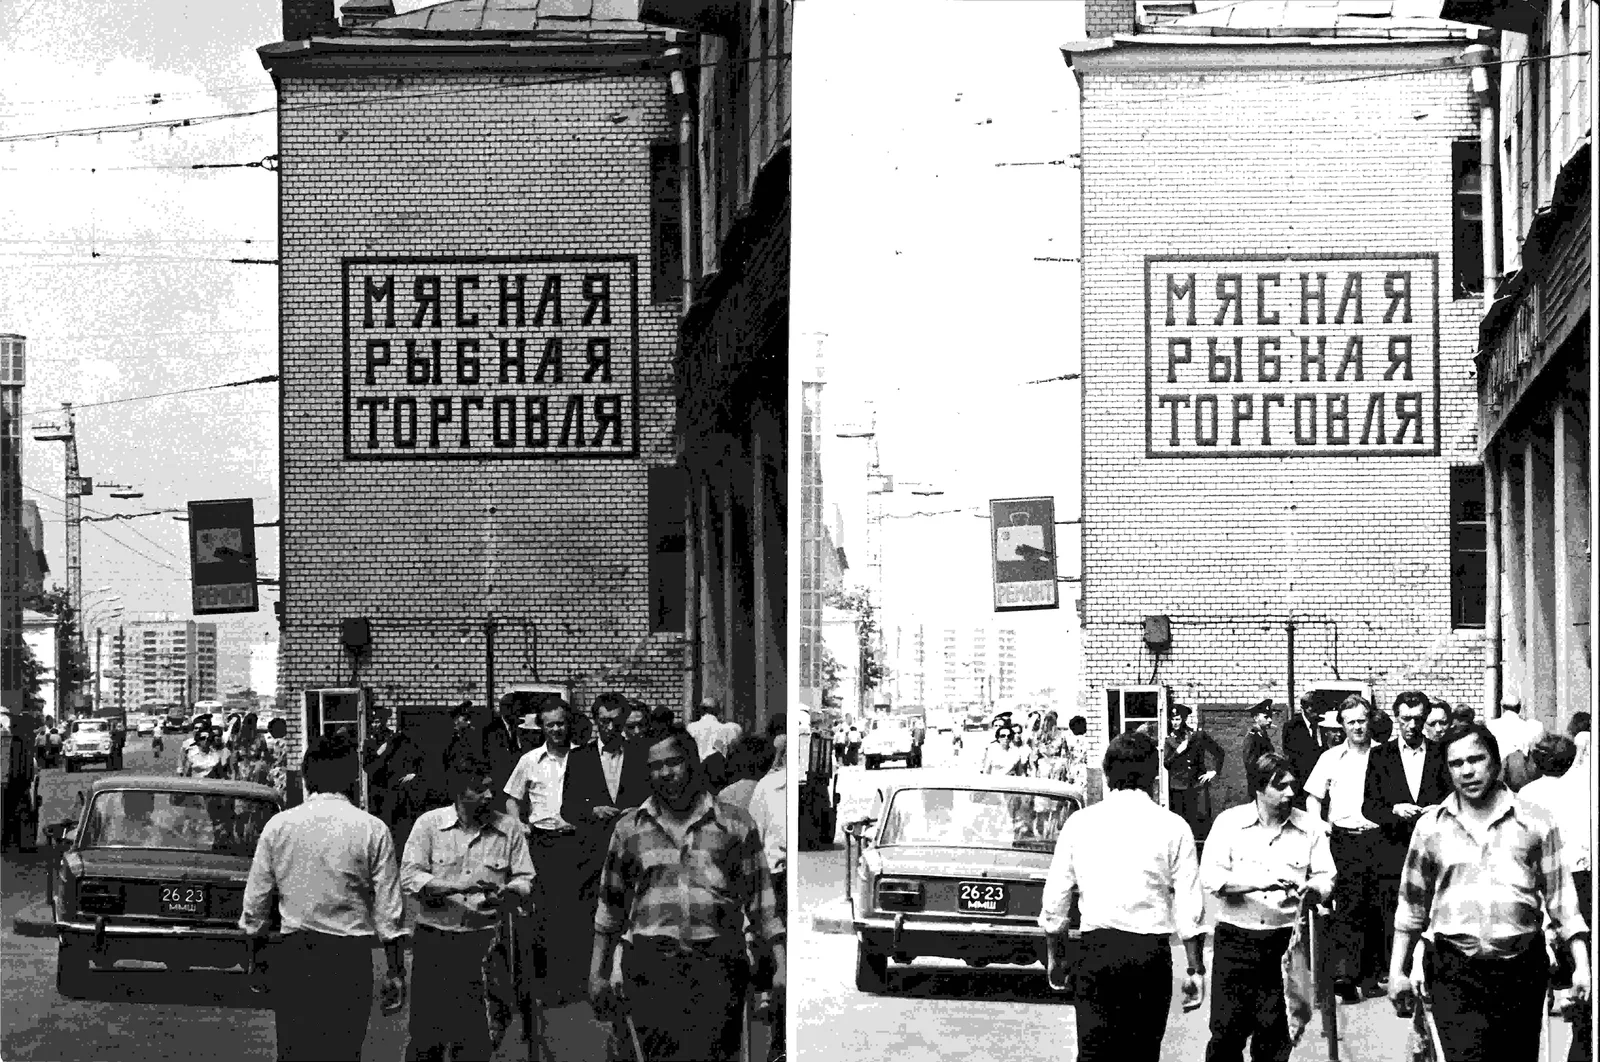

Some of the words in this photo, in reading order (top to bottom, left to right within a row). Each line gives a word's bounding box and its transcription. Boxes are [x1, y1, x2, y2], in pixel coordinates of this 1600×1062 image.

[363, 273, 610, 328] МЯСНАЯ
[1165, 271, 1413, 325] МЯСНАЯ
[365, 337, 611, 385] РЫБНАЯ
[1167, 334, 1413, 383] РЫБНАЯ
[357, 394, 622, 448] ТОРГОВЛЯ
[1158, 392, 1424, 446] ТОРГОВЛЯ
[961, 885, 1004, 900] 26-23
[968, 900, 996, 910] ММШ
